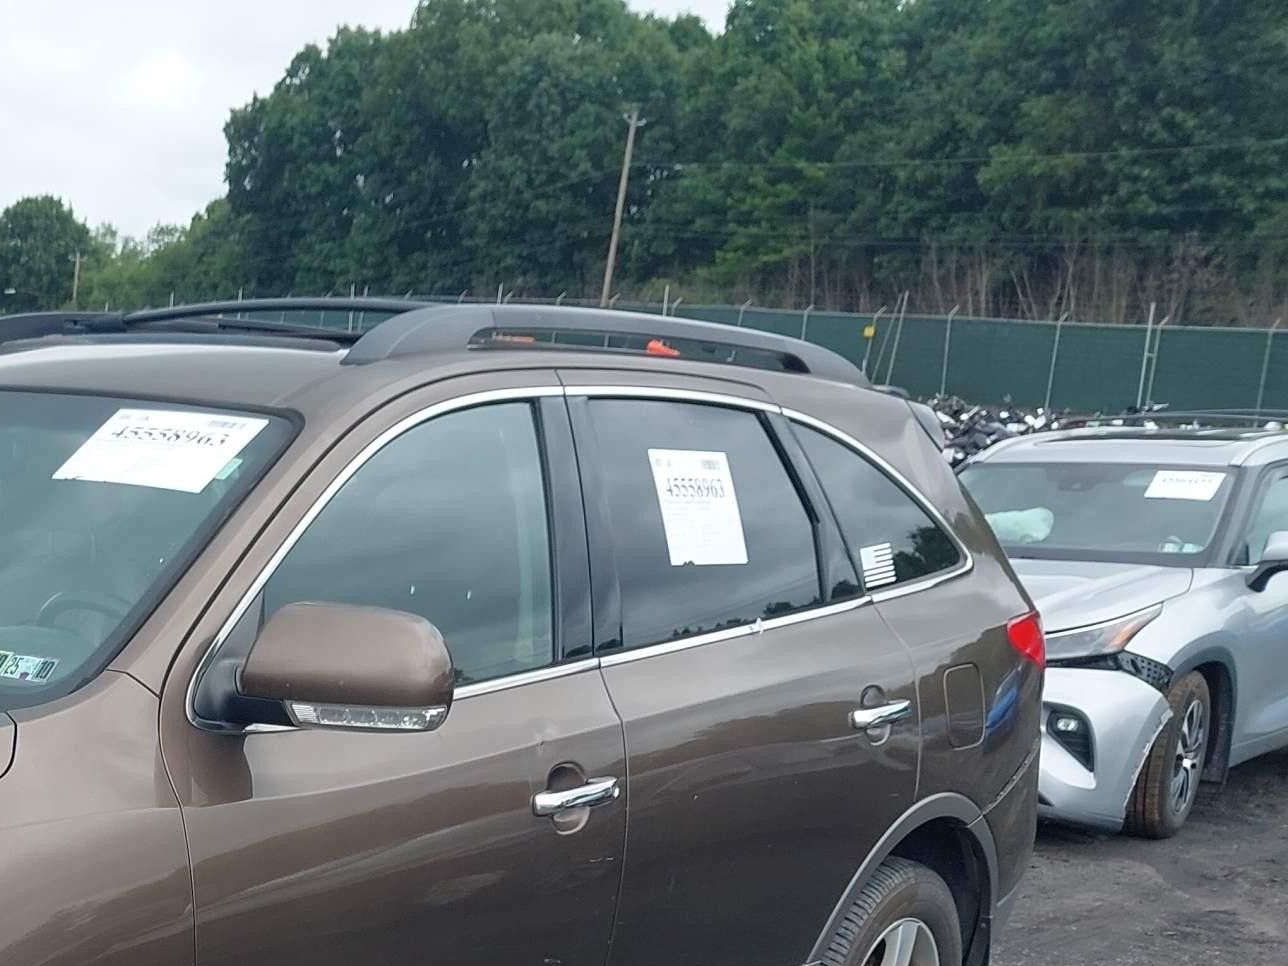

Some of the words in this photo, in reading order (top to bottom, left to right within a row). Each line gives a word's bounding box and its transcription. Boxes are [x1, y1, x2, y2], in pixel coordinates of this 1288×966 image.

[111, 424, 230, 448] 45558963
[666, 476, 726, 499] 45558963
[5, 656, 25, 675] 25
[35, 660, 56, 680] 10
